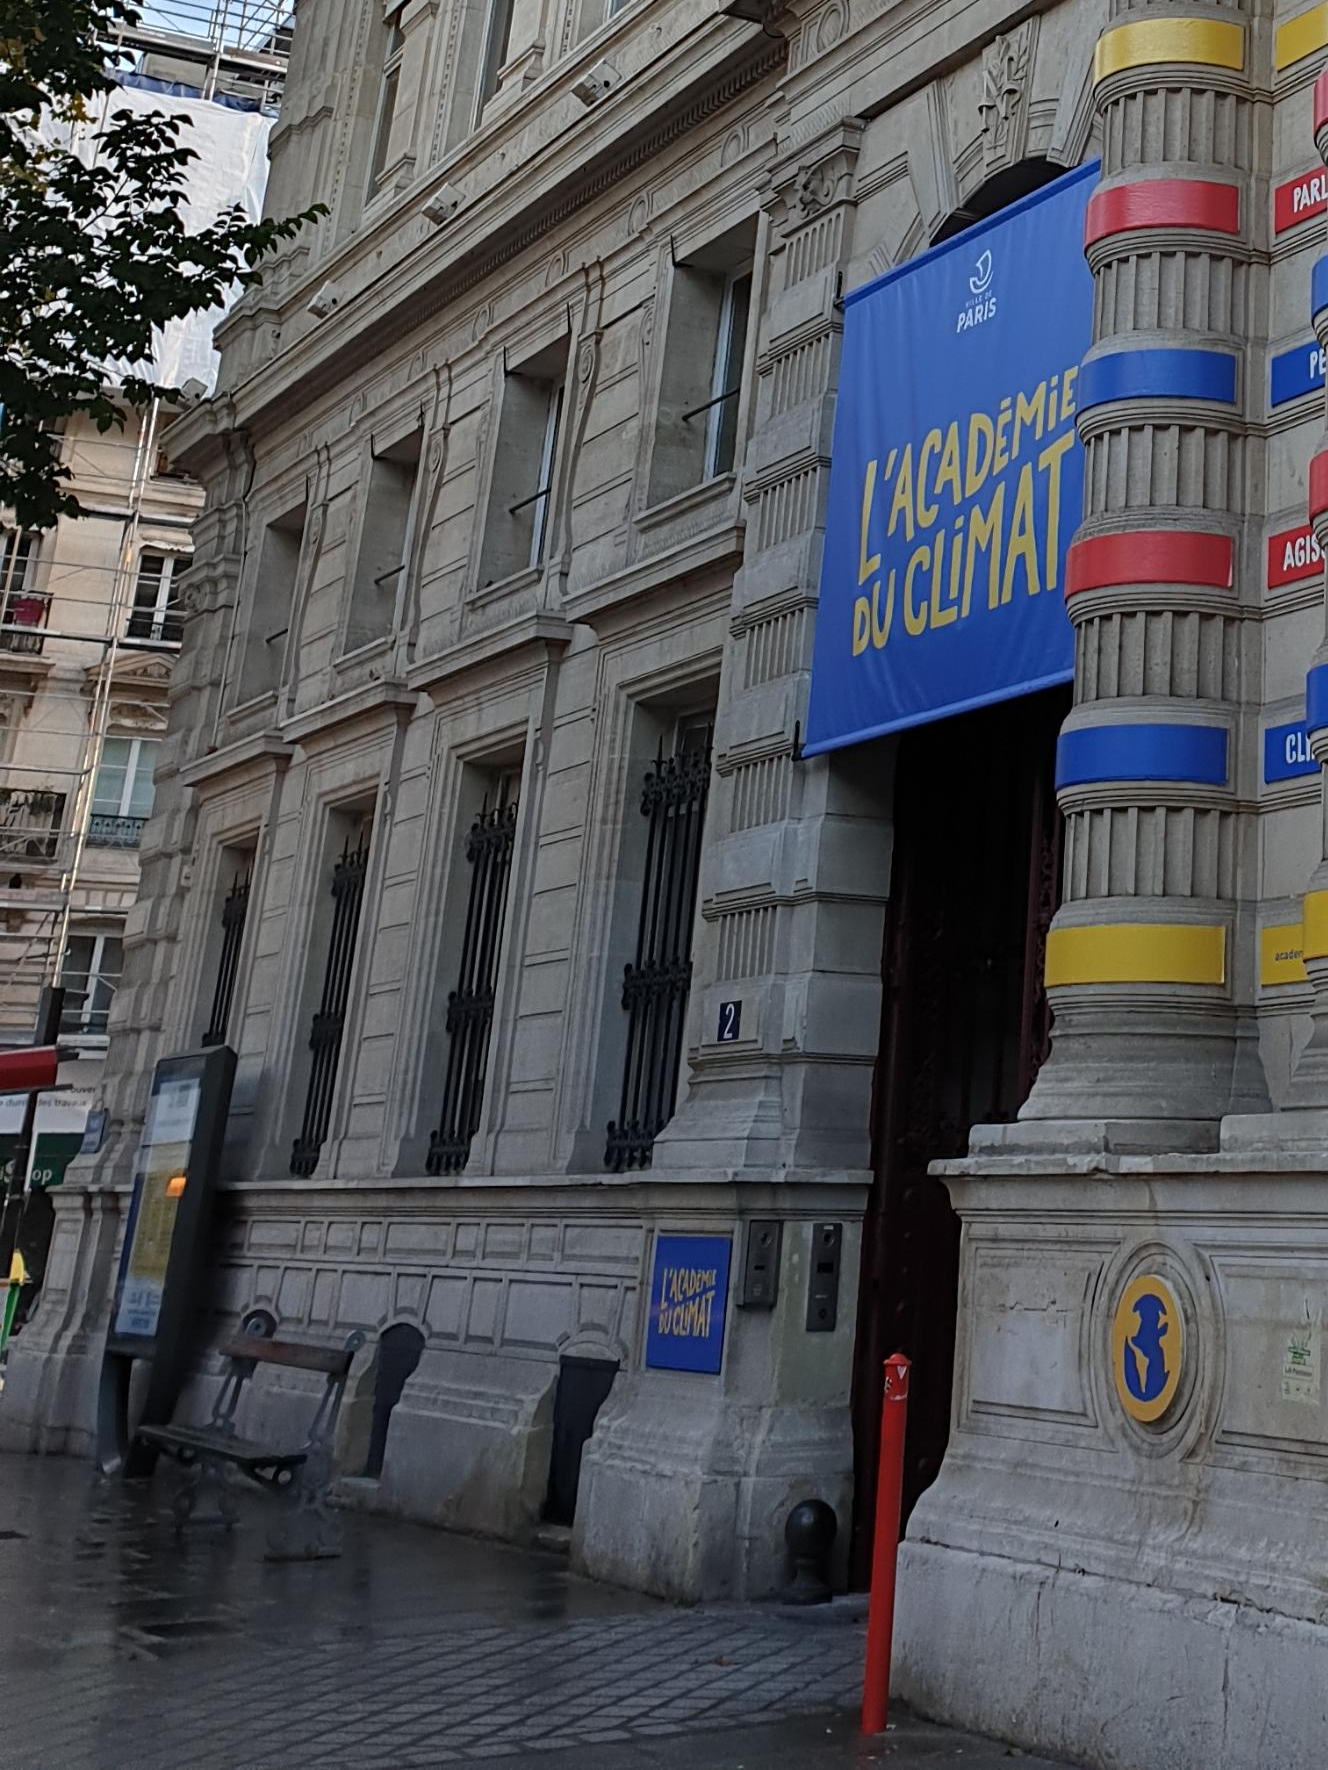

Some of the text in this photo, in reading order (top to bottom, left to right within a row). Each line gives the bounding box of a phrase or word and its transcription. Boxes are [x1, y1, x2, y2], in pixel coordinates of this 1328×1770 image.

[956, 296, 998, 334] PARIS
[1282, 530, 1326, 572] AGIS
[851, 566, 897, 658] DU
[1285, 731, 1316, 764] CLI
[723, 1002, 735, 1039] 2
[658, 1308, 673, 1335] DU
